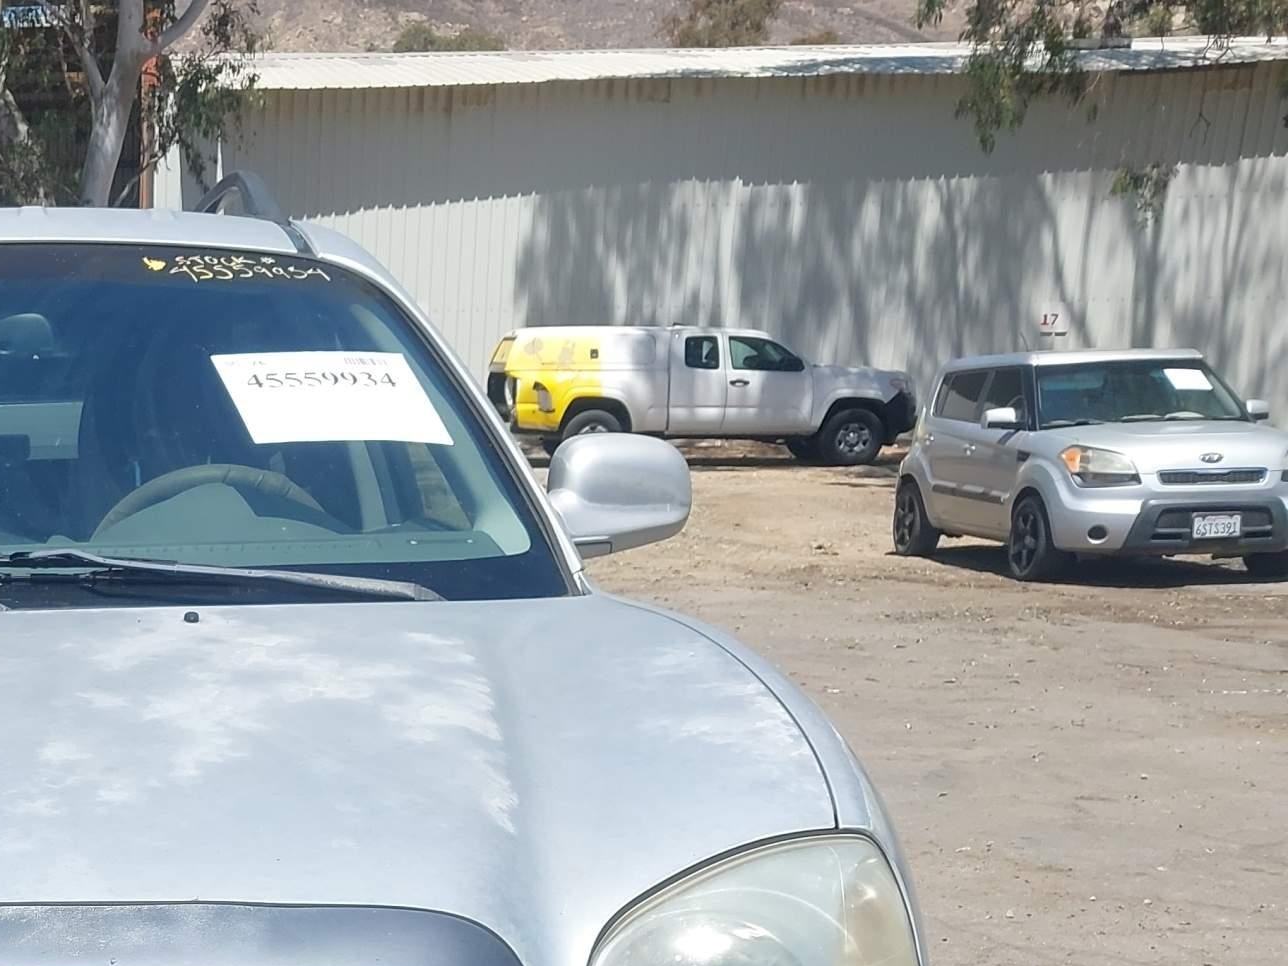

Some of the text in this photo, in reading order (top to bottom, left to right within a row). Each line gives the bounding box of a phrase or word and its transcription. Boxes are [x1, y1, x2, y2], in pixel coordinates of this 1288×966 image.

[175, 255, 256, 266] STOCK
[1040, 313, 1059, 326] 17
[247, 371, 396, 388] 45559934
[1195, 521, 1238, 536] 6STS391
